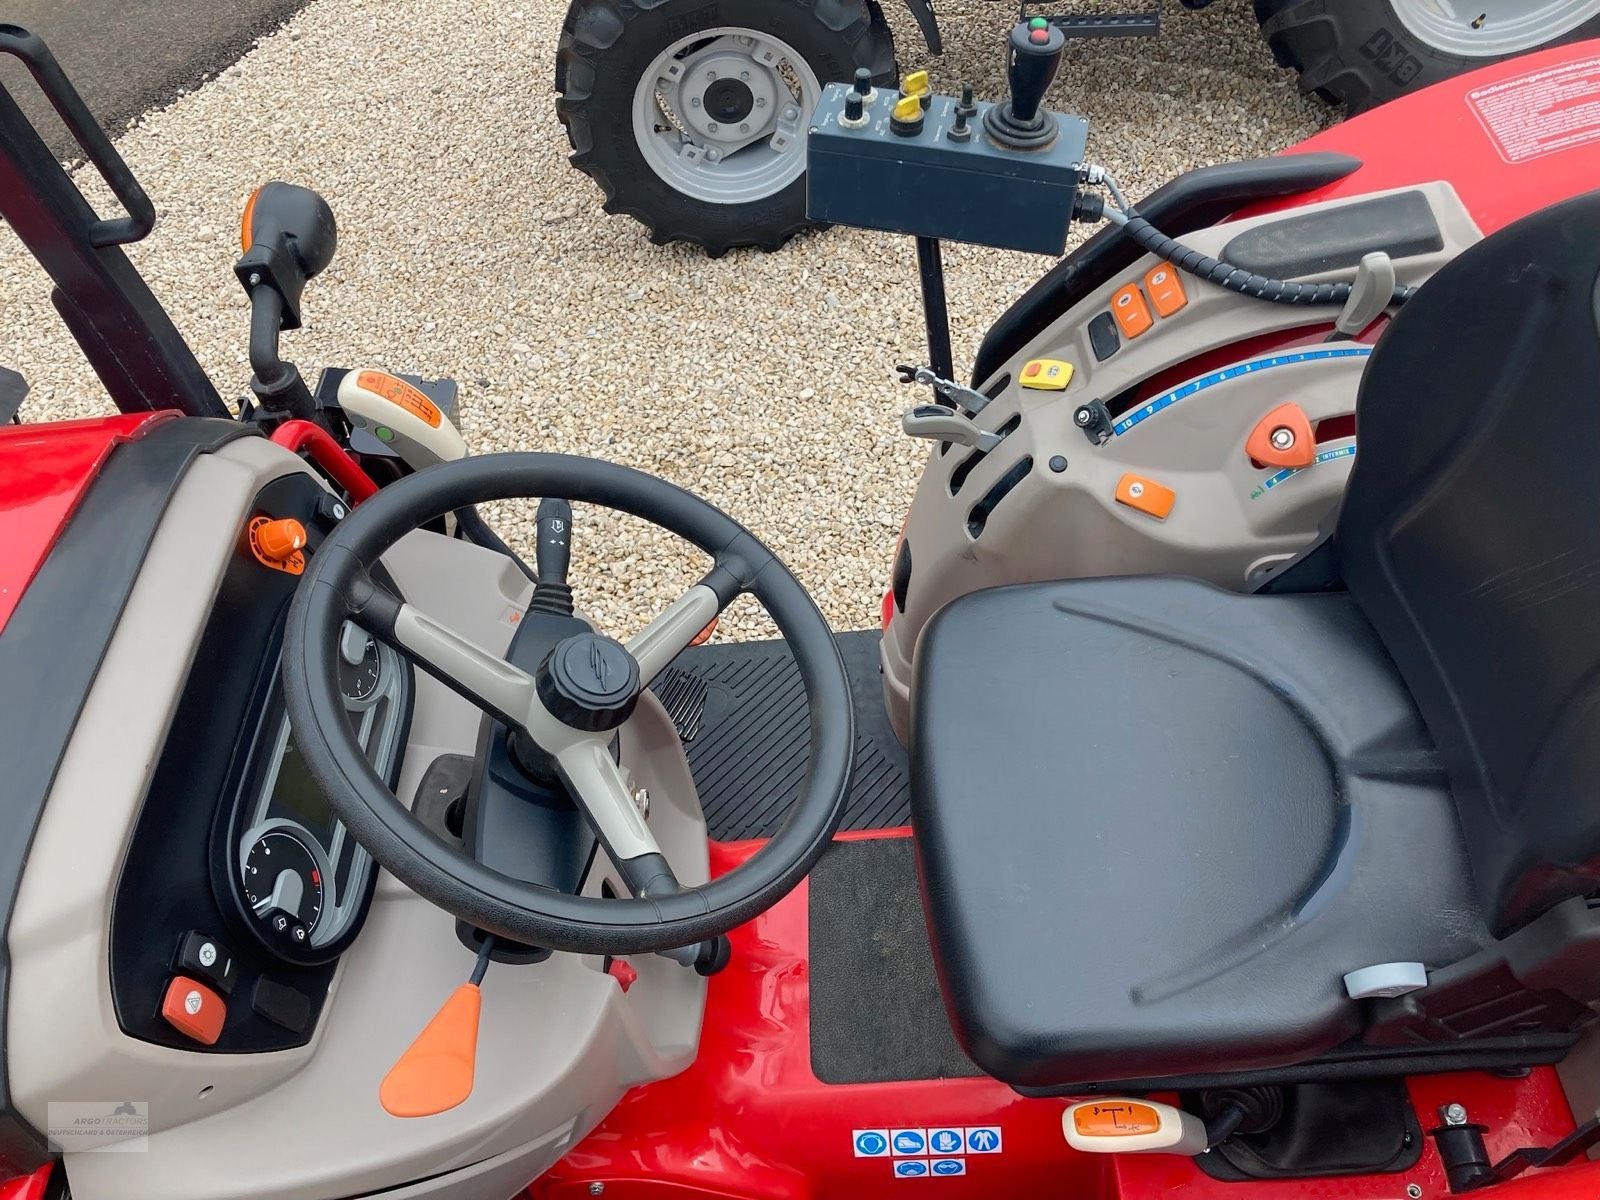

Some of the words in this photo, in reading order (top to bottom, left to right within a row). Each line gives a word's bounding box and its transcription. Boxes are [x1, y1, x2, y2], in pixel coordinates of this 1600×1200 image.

[1359, 28, 1424, 87] BKT
[1121, 419, 1133, 430] 10
[1146, 405, 1154, 414] 9
[1170, 393, 1177, 402] 8
[1194, 382, 1202, 390] 7
[1246, 364, 1252, 372] 5
[1322, 449, 1349, 459] INTERMIX
